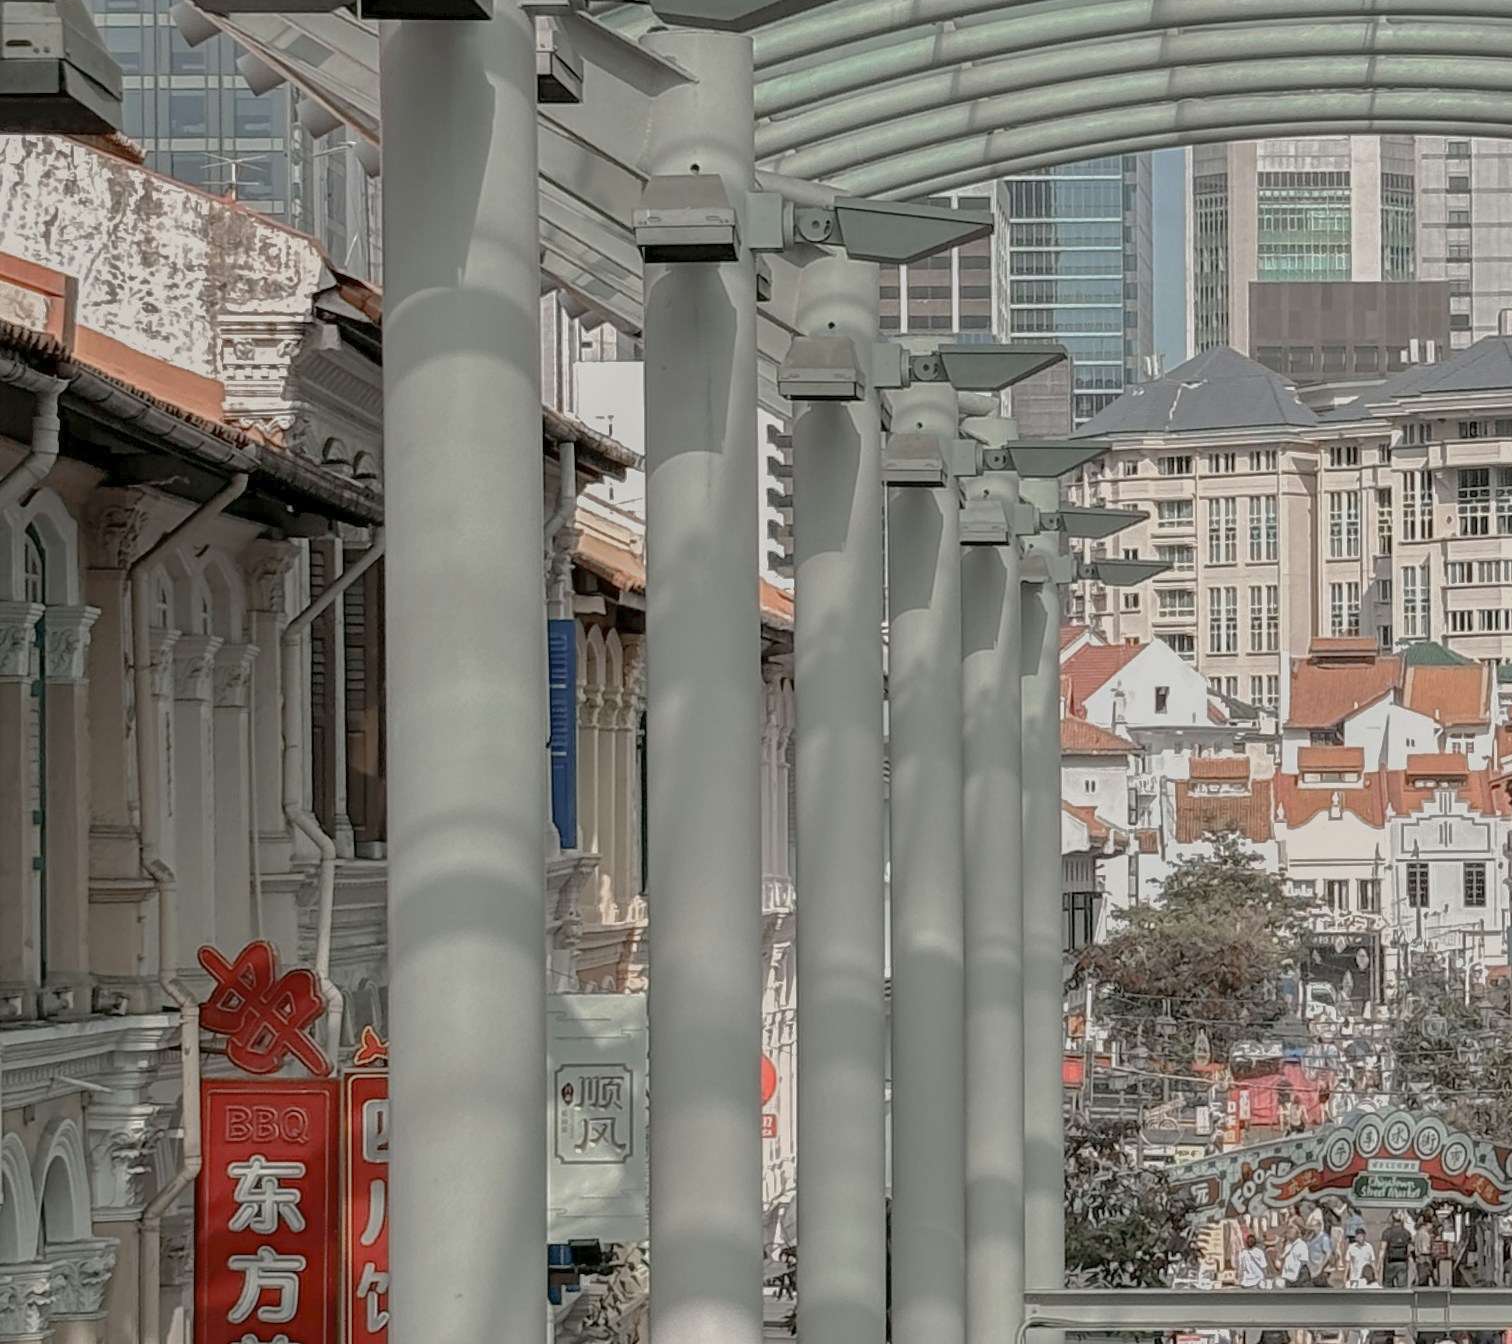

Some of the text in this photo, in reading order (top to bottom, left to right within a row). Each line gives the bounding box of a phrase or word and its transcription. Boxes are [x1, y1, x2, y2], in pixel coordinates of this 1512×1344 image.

[225, 1106, 309, 1144] BBQ
[574, 1075, 627, 1154] 顺风
[1360, 1185, 1421, 1199] Street Market
[1367, 1176, 1415, 1189] Chinatown
